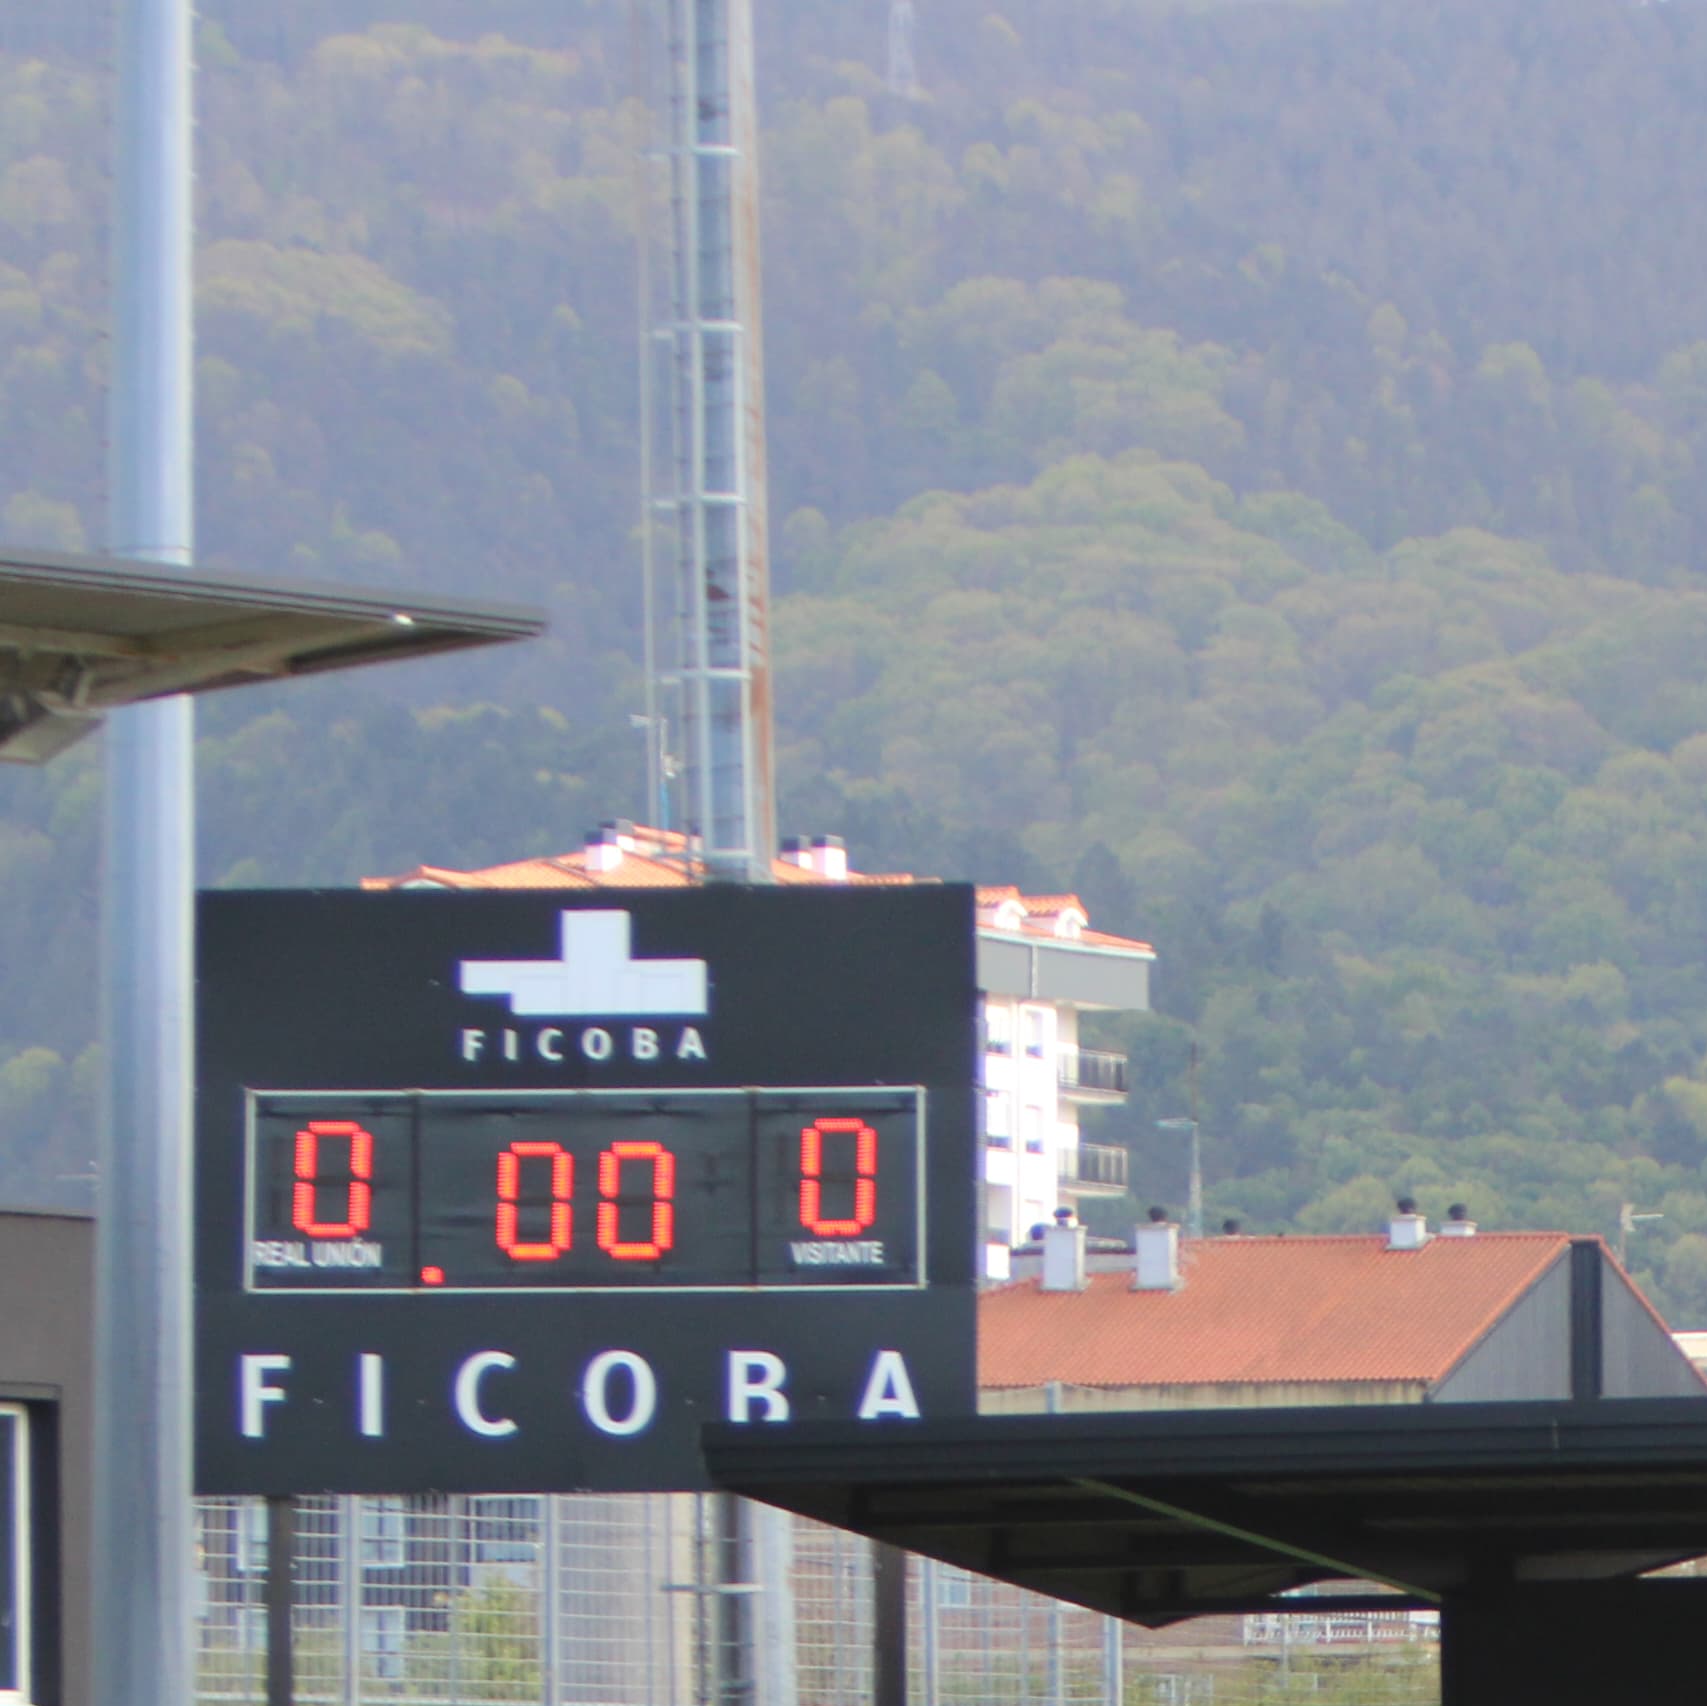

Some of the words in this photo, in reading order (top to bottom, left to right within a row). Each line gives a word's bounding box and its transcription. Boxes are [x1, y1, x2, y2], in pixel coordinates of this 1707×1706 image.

[462, 1027, 708, 1062] FICOBA
[292, 1121, 373, 1238] 0
[495, 1141, 676, 1260] 00
[799, 1117, 876, 1235] 0
[253, 1241, 311, 1267] REAL
[312, 1235, 382, 1268] UNIÓN
[790, 1241, 884, 1265] VISITANTE
[240, 1350, 922, 1439] FICOBA
